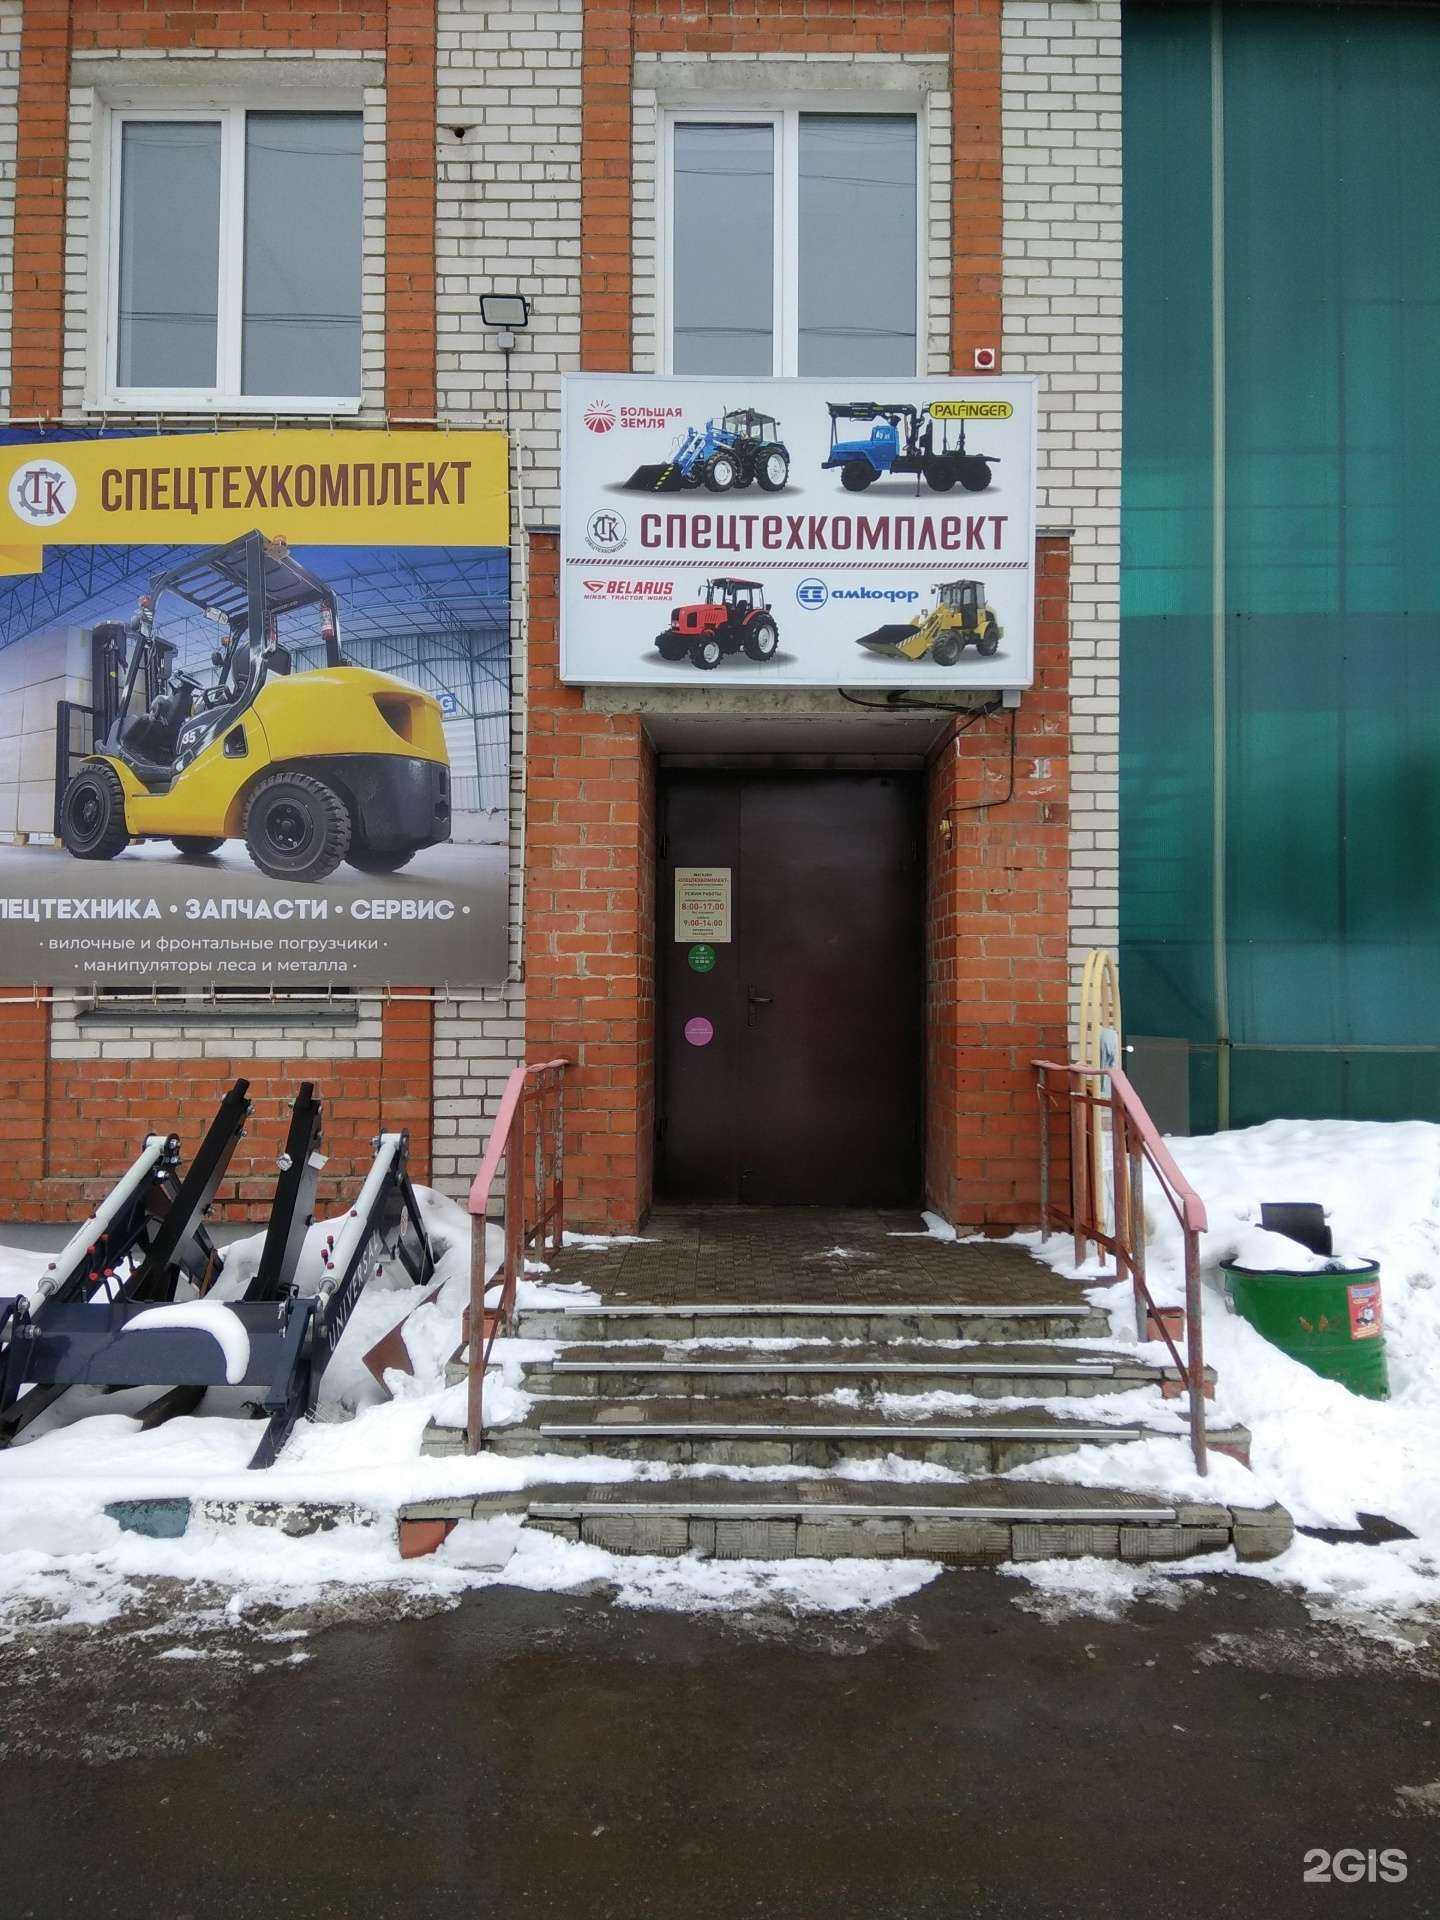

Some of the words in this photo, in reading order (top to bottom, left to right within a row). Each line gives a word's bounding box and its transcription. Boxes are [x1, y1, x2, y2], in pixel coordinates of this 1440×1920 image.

[620, 406, 682, 417] БОЛЬШАЯ
[935, 404, 1007, 416] PALFINGER
[620, 418, 665, 429] ЗЕМЛЯ
[101, 461, 472, 515] СПЕЦТЕХКОМПЛЕКТ
[606, 580, 674, 595] BELARUS
[185, 898, 328, 920] ЗАПЧАСТИ
[350, 899, 455, 920] СЕРВИС
[49, 937, 135, 950] вилочные
[140, 938, 151, 950] и
[156, 935, 274, 952] фронтальные
[278, 938, 379, 952] погрузчики
[83, 960, 212, 975] манипуляторы
[217, 961, 256, 972] леса
[262, 961, 272, 972] и
[277, 960, 348, 972] металла
